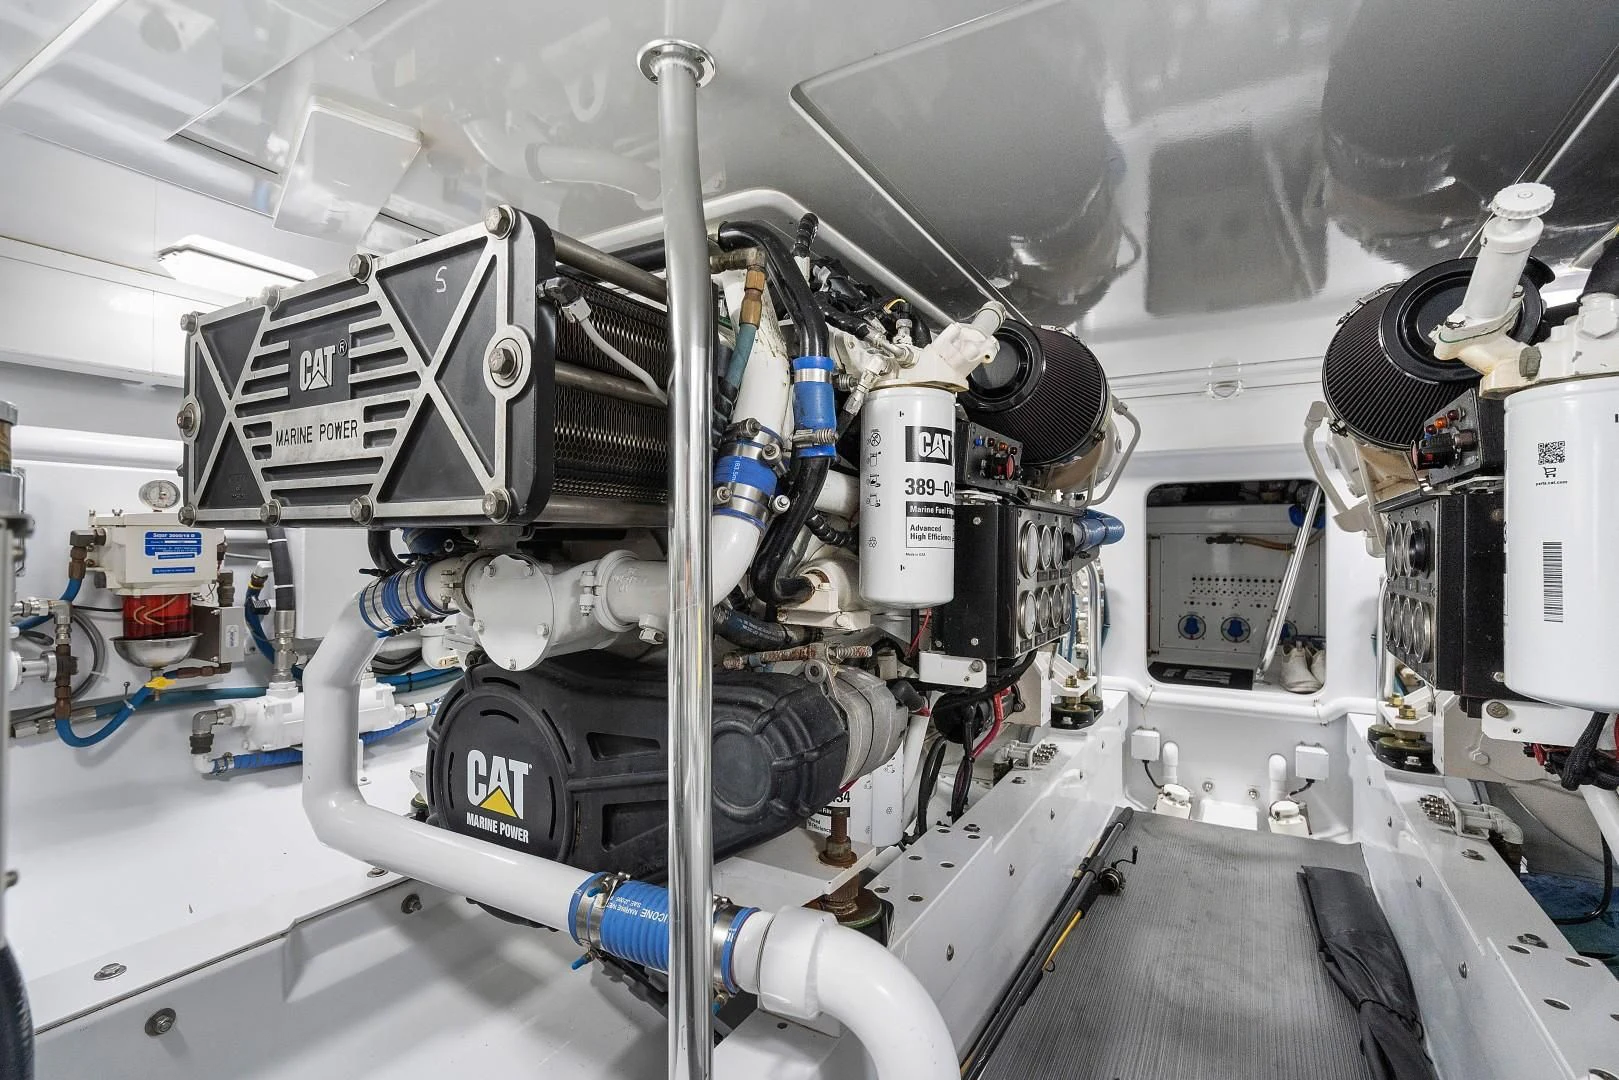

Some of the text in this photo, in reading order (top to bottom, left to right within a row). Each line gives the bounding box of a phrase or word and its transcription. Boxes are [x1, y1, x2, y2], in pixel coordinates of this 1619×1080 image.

[275, 419, 358, 447] MARINE POWER
[909, 505, 935, 514] Marine
[910, 524, 942, 532] Advanced
[910, 533, 926, 541] High
[466, 811, 529, 844] MARINE POWER
